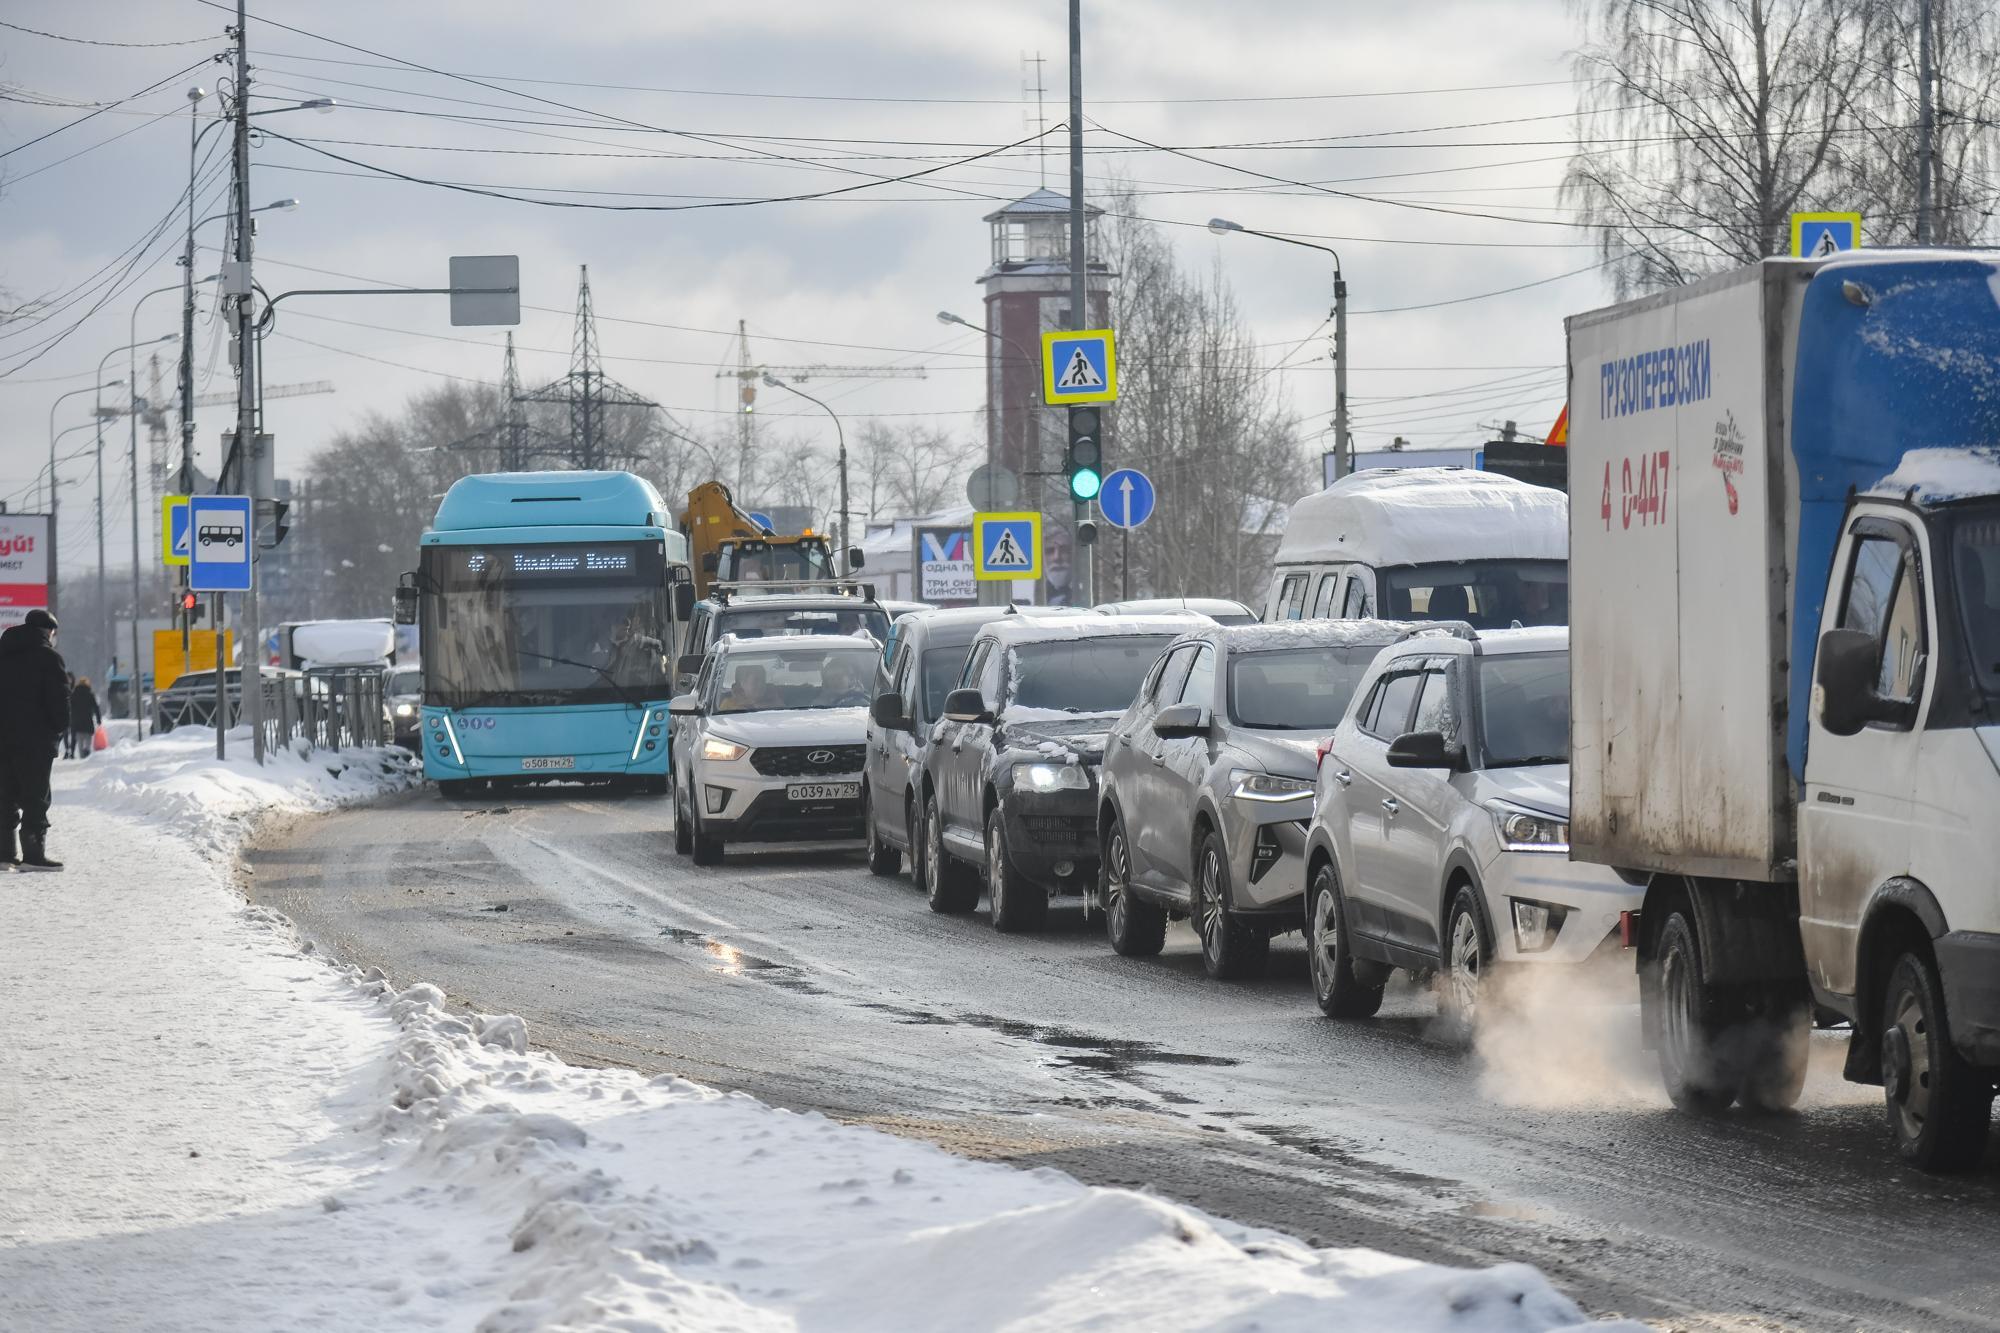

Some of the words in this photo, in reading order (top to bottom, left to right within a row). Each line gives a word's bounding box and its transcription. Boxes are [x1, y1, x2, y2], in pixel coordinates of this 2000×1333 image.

[1601, 338, 1711, 420] ГРУЗОПЕРЕВОЗКИ
[926, 564, 958, 572] ОДНА
[926, 579, 948, 587] ТРИ
[791, 786, 840, 798] О039АУ
[844, 784, 855, 794] 29
